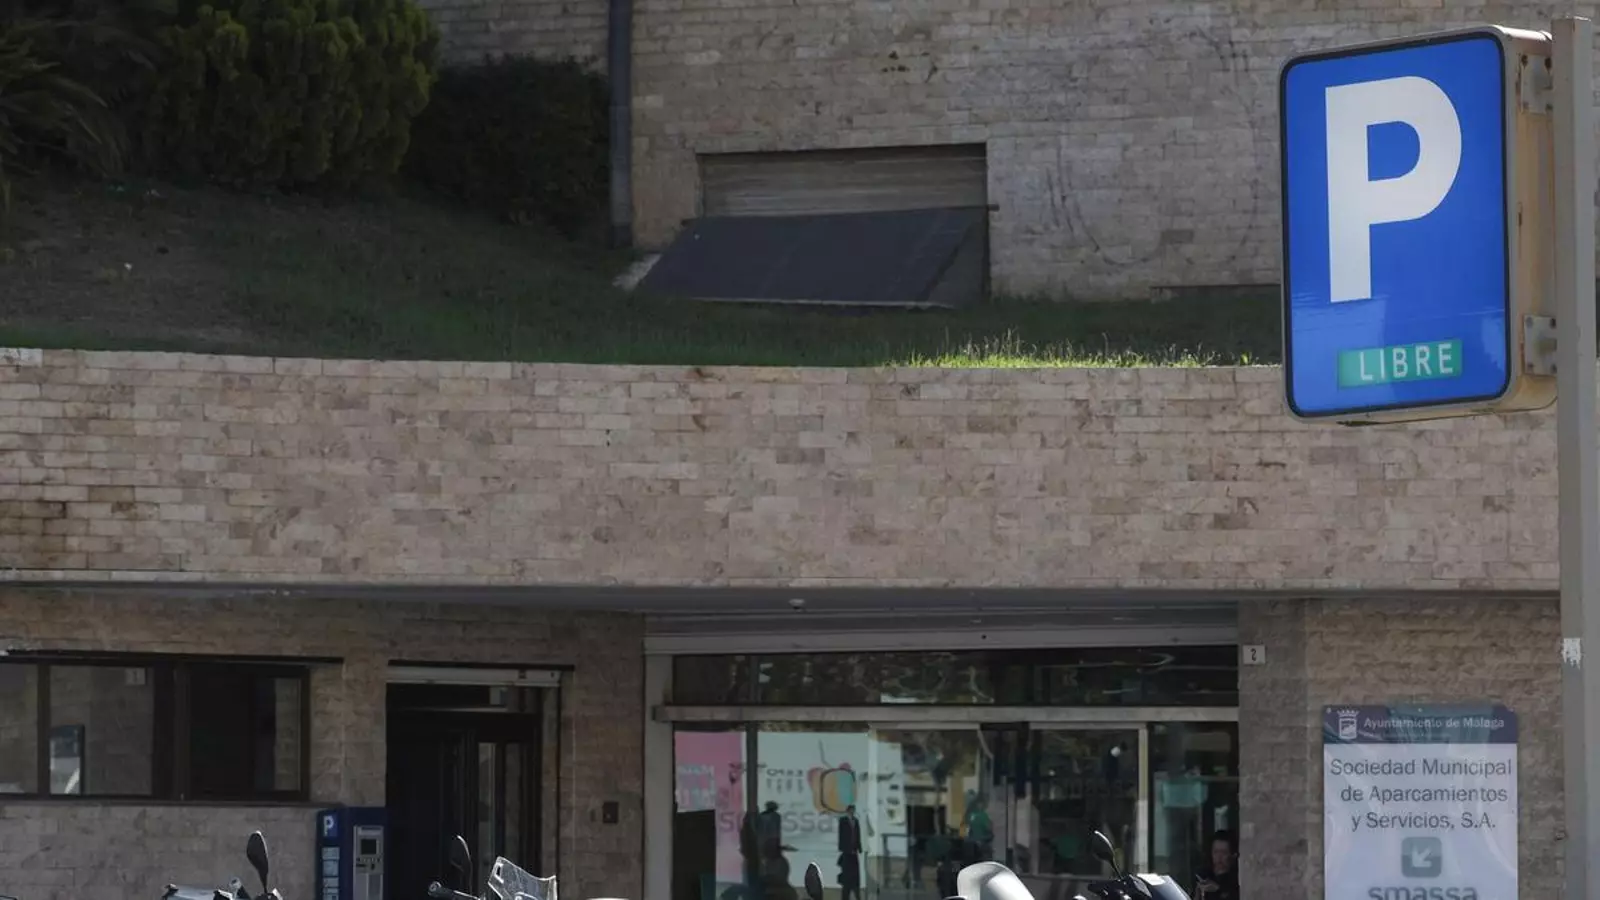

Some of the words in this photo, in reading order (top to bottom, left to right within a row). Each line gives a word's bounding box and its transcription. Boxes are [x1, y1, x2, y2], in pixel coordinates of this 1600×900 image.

[1325, 76, 1462, 303] P
[1358, 342, 1453, 381] LIBRE
[1446, 717, 1459, 728] de
[1331, 758, 1416, 775] Sociedad
[1423, 758, 1512, 779] Municipal
[1341, 785, 1363, 802] de
[1369, 785, 1508, 804] Aparcamientos
[323, 815, 334, 837] P
[719, 811, 834, 833] sssa
[1352, 815, 1362, 832] y
[1366, 812, 1455, 829] Servicios,
[1461, 812, 1496, 829] S.A.
